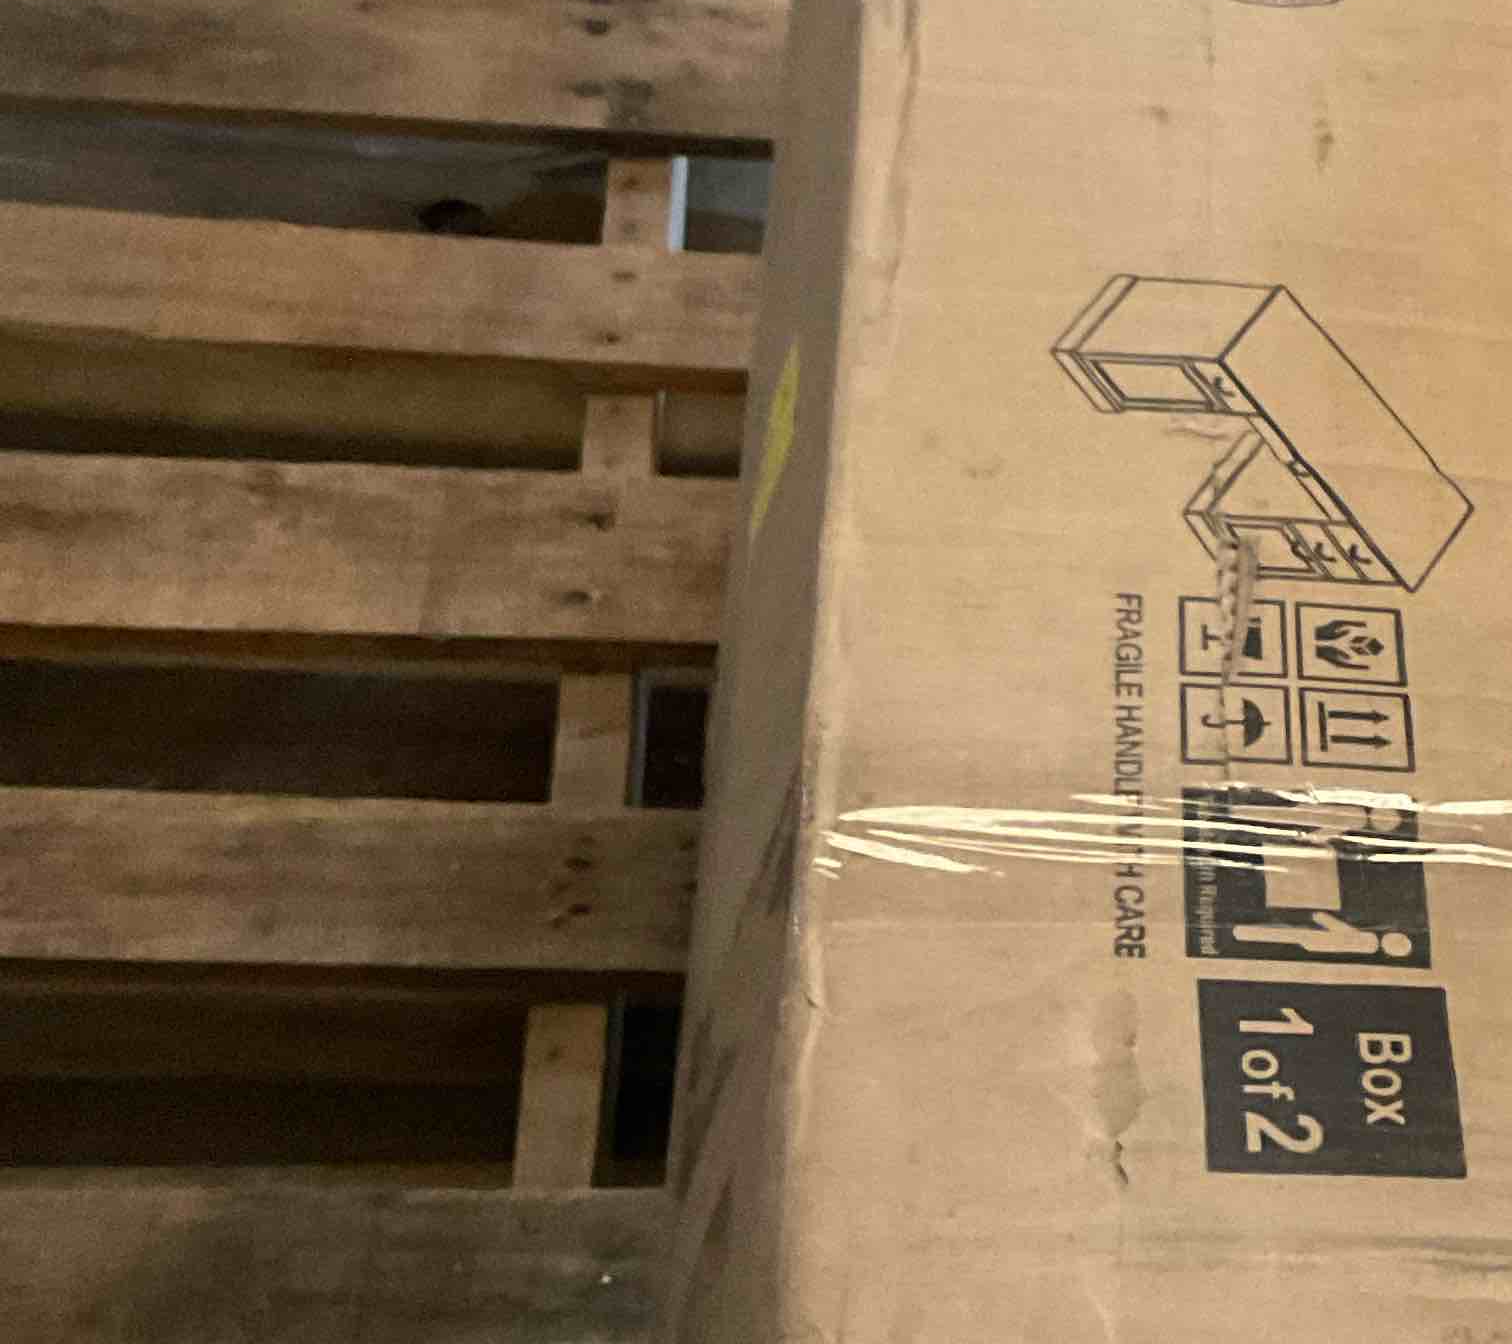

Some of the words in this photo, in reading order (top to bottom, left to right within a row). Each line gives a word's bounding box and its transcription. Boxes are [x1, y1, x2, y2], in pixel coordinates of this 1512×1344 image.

[1114, 592, 1143, 697] FRAGILE
[1113, 886, 1146, 958] CARE
[1239, 1008, 1314, 1035] 1
[1241, 1049, 1295, 1100] of
[1358, 1032, 1412, 1125] Box
[1245, 1111, 1324, 1153] 2
